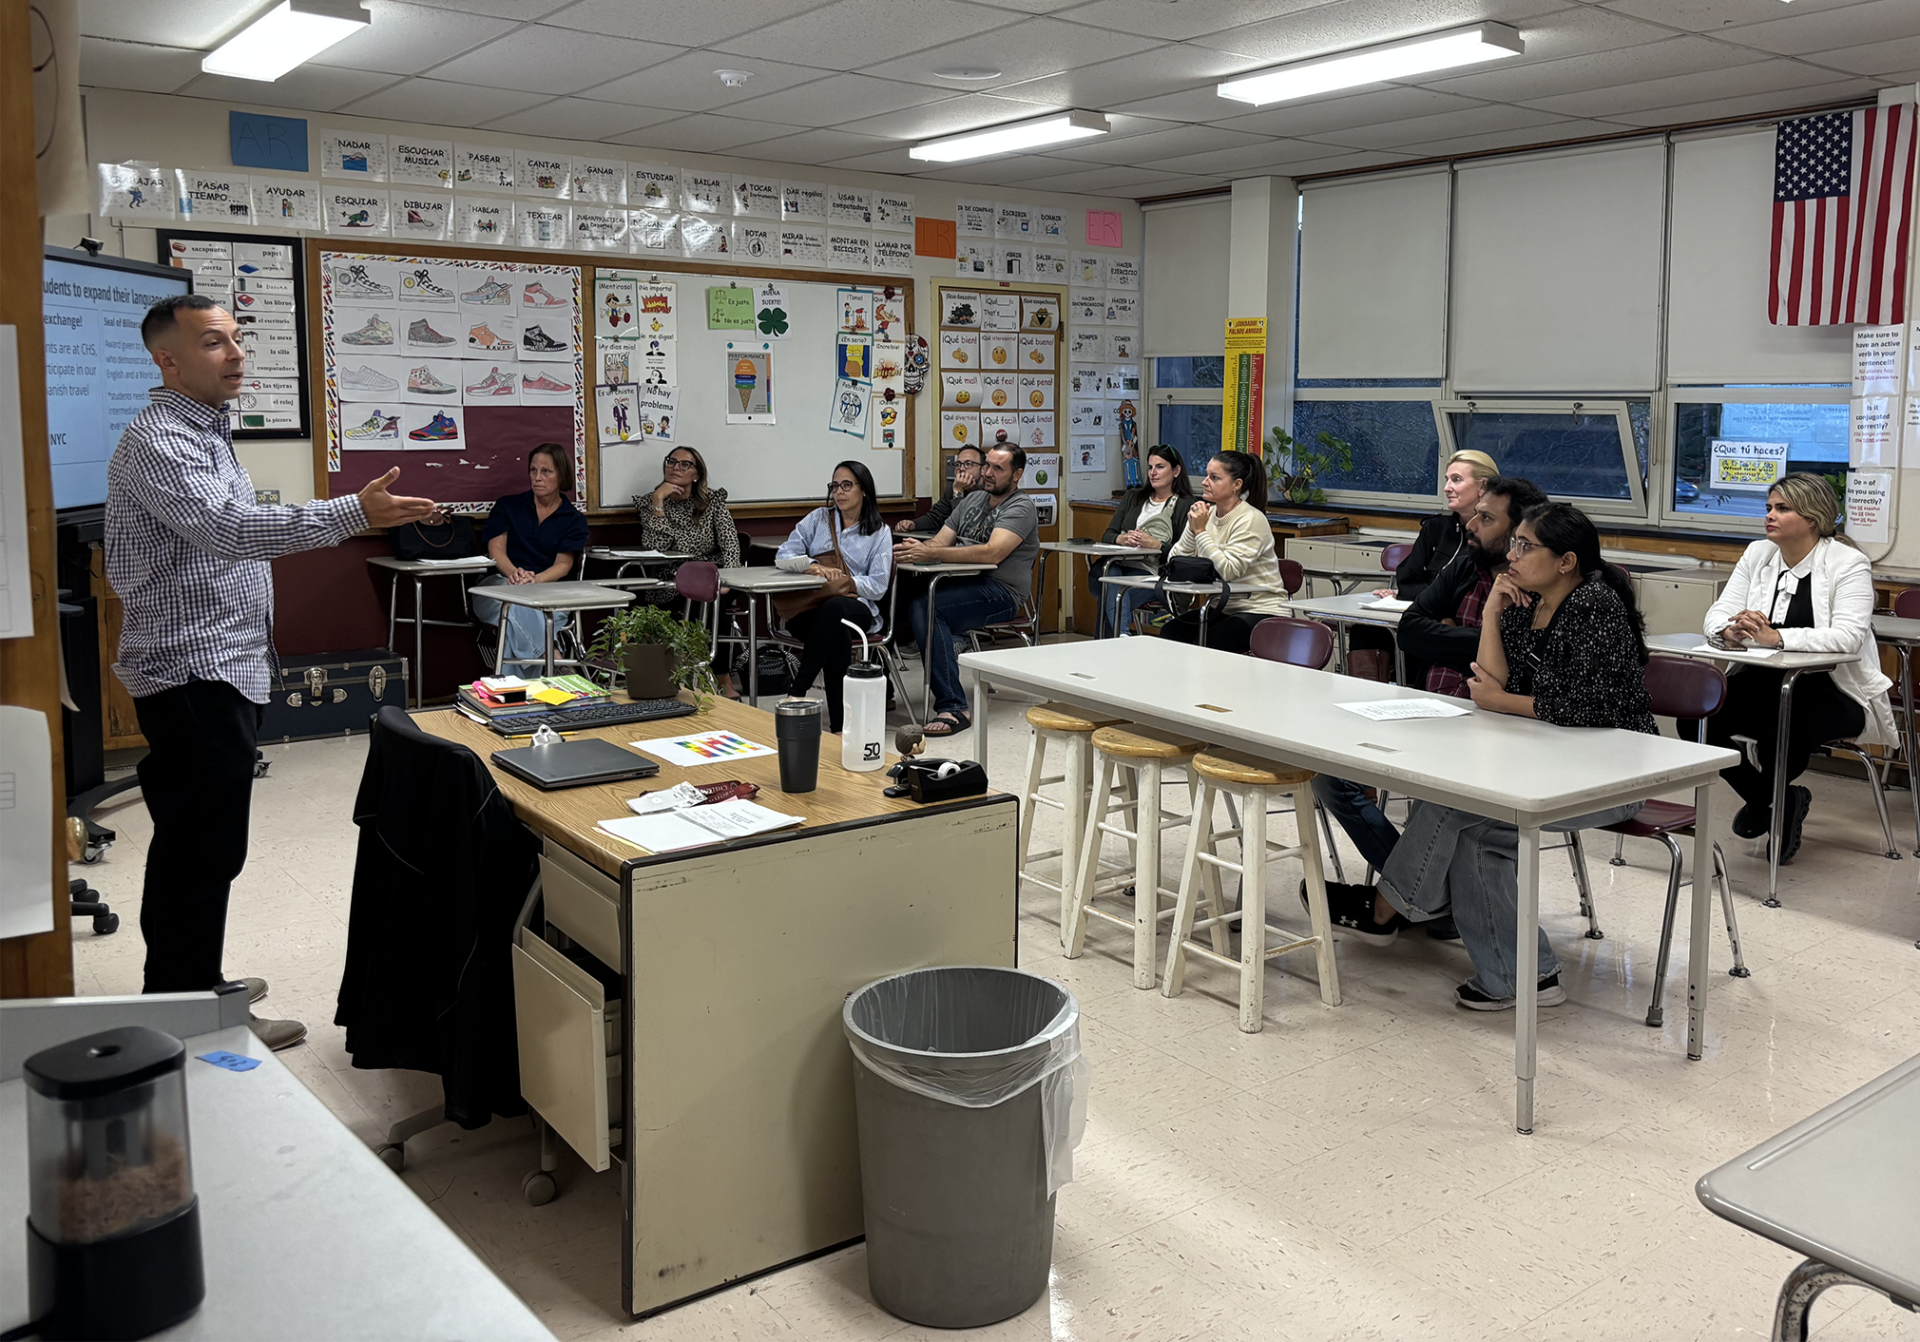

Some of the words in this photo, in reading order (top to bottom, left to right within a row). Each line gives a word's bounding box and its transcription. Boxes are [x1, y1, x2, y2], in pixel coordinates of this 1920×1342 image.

[236, 122, 293, 159] AR
[338, 140, 371, 150] NADAR
[398, 145, 445, 157] ESCUCHAR
[404, 157, 440, 166] MUSICA
[468, 153, 501, 163] PASEAR
[528, 160, 561, 170] CANTAR
[586, 166, 614, 175] GANAR
[636, 171, 674, 182] ESTUDIAR
[197, 181, 230, 191] PASAR
[694, 178, 720, 187] BAILAR
[266, 187, 306, 198] AYUDAR
[749, 183, 772, 193] TOCAR
[801, 191, 823, 199] regalos
[838, 194, 855, 202] USAR
[335, 195, 378, 206] ESQUIAR
[403, 200, 444, 211] DIBUJAR
[880, 198, 908, 208] PATINAR
[472, 206, 500, 215] HABLAR
[832, 202, 869, 212] computadora
[527, 211, 563, 221] TEXTEAR
[1002, 208, 1028, 218] ESCRIBIR
[1040, 214, 1062, 222] DORMIR
[1089, 211, 1118, 243] ER
[745, 229, 768, 239] BOTAR
[781, 232, 804, 242] MIRAR
[830, 237, 859, 246] MONTAR
[859, 240, 869, 248] EN
[874, 241, 899, 249] LLAMAR
[900, 243, 913, 251] POR
[833, 246, 867, 255] BICICLETA
[1110, 268, 1138, 276] EJERCICIO
[599, 283, 632, 292] ¡Mentiroso!
[73, 283, 82, 298] to
[84, 285, 111, 304] expand
[113, 288, 131, 304] their
[44, 313, 83, 330] exchange!
[104, 317, 115, 327] Seal
[1245, 327, 1263, 335] AMIGOS
[1857, 332, 1875, 340] Make
[1892, 331, 1899, 339] to
[942, 335, 960, 345] ¡Qué
[961, 336, 978, 345] bien!
[1019, 337, 1035, 346] ¡Qué
[1035, 338, 1054, 346] bueno!
[1880, 340, 1900, 349] active
[59, 345, 72, 354] are
[73, 345, 81, 355] at
[81, 343, 98, 357] CHS,
[610, 343, 623, 352] dios
[1858, 350, 1872, 359] verb
[1881, 351, 1897, 360] your
[76, 364, 83, 375] in
[1078, 370, 1097, 378] PERDER
[946, 376, 963, 386] ¡Qué
[983, 376, 1000, 386] ¡Qué
[1001, 377, 1015, 386] feo!
[1019, 378, 1036, 387] ¡Qué
[1036, 379, 1053, 388] pena!
[69, 386, 90, 397] travel
[598, 389, 606, 398] Es
[658, 388, 672, 397] hay
[641, 400, 674, 411] problema
[1081, 407, 1093, 415] LEER
[983, 416, 1000, 426] ¡Qué
[1021, 416, 1036, 424] ¡Qué
[1037, 415, 1053, 424] lindo!
[1856, 413, 1891, 423] conjugated
[1857, 422, 1889, 433] correctly?
[50, 433, 67, 446] NYC
[1714, 444, 1737, 455] ¿Que
[1741, 445, 1751, 454] tú
[1754, 445, 1785, 456] haces?
[1042, 458, 1057, 466] asco!
[1868, 489, 1886, 497] using
[863, 742, 881, 757] 50
